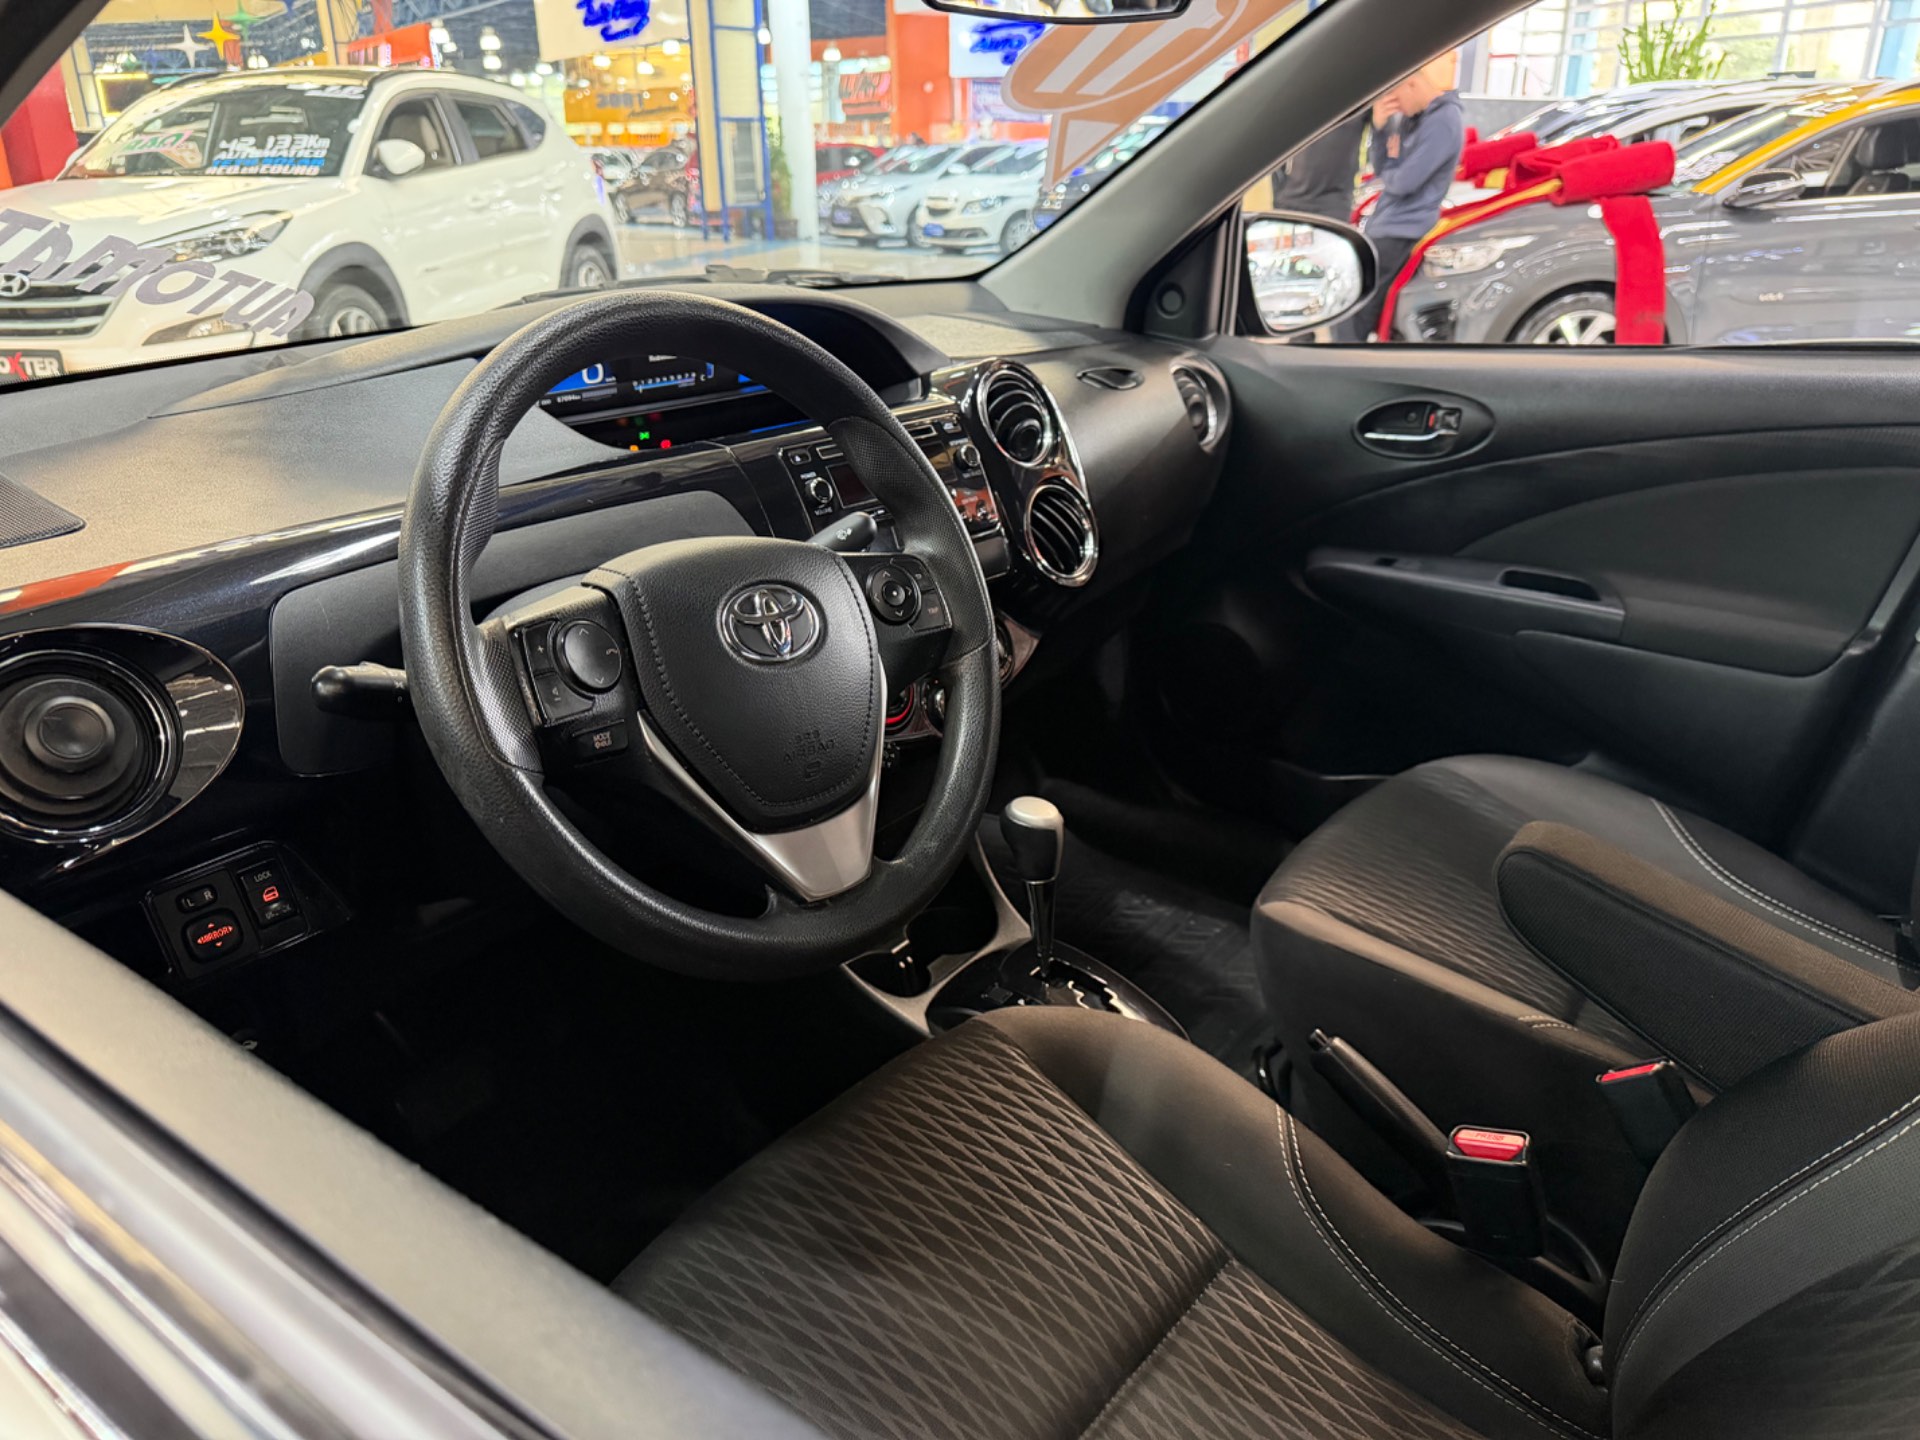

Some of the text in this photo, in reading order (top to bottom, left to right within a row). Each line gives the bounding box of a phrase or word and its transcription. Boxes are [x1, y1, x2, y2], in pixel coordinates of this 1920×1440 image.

[253, 870, 272, 883] LOCK
[203, 889, 214, 901] R
[201, 926, 229, 944] MIRROR
